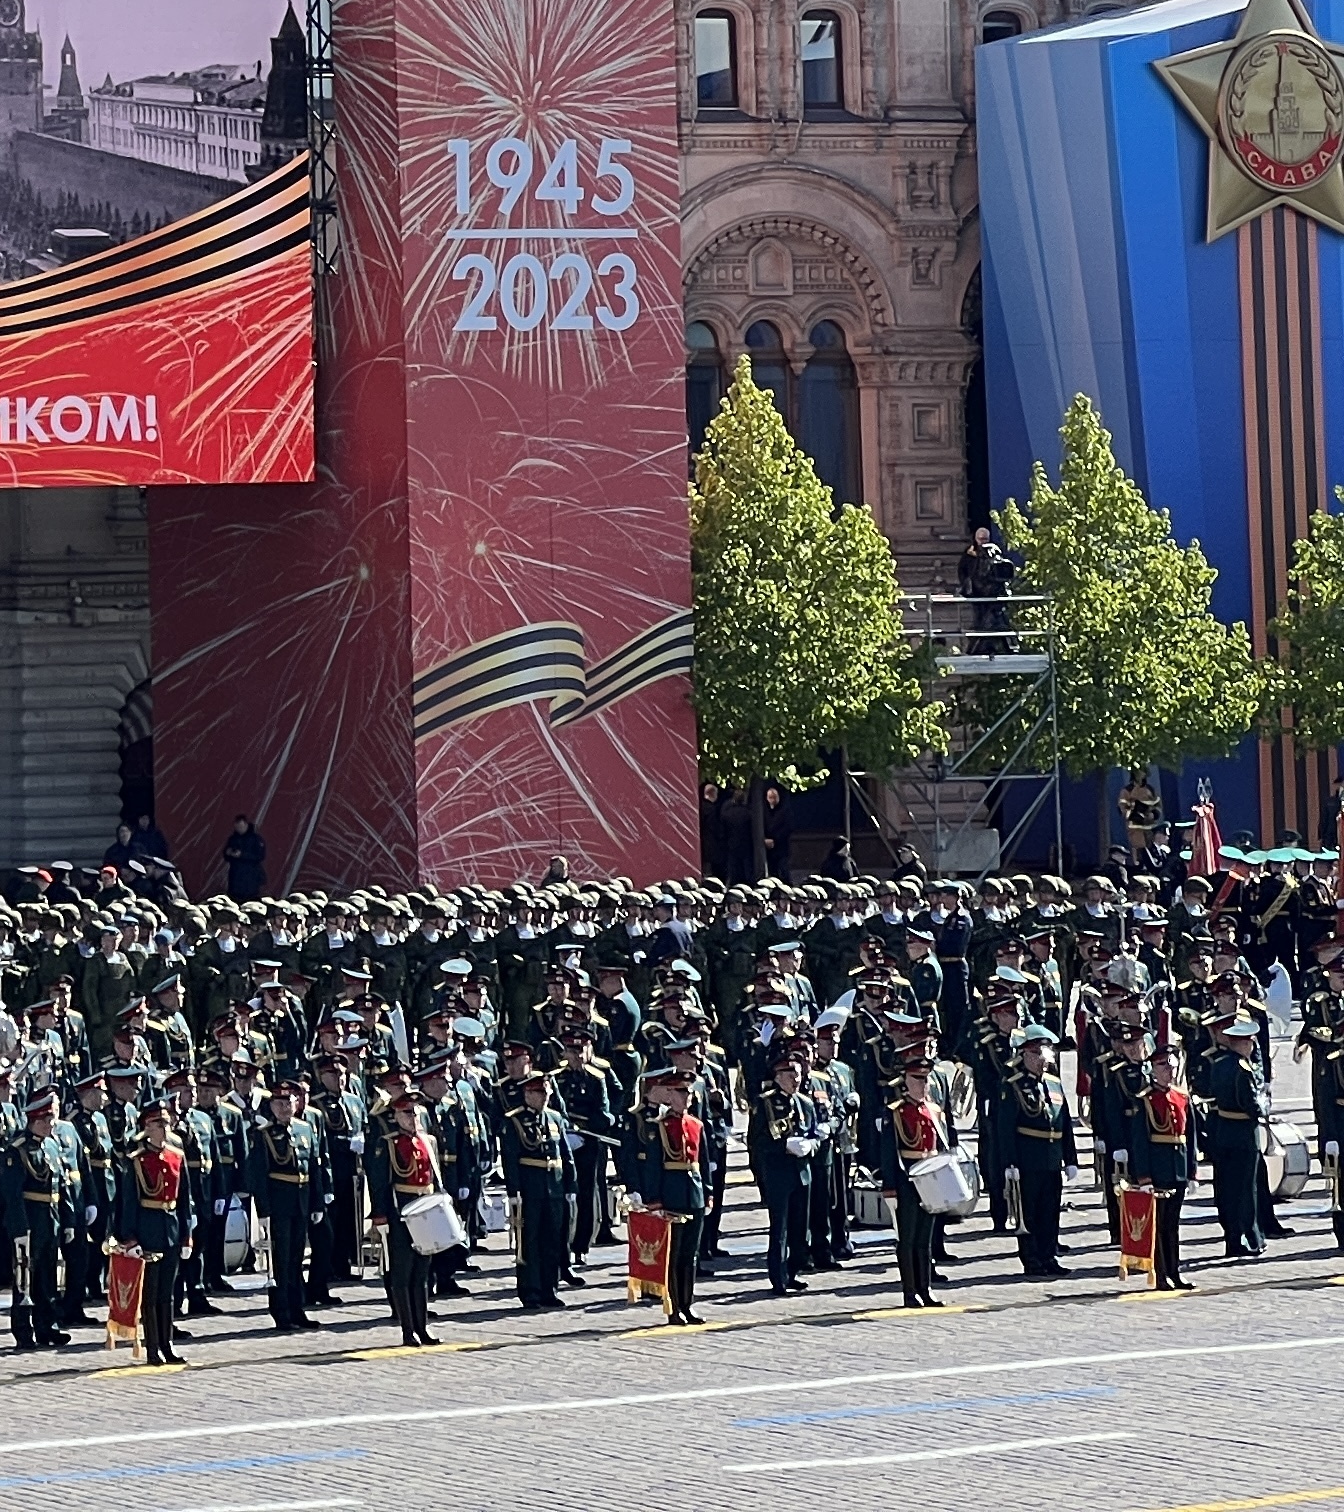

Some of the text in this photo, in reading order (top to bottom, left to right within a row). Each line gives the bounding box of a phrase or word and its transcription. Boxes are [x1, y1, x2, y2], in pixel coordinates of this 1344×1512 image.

[447, 137, 635, 216] 1945
[1247, 150, 1332, 184] СЛАВА
[451, 252, 640, 332] 2023
